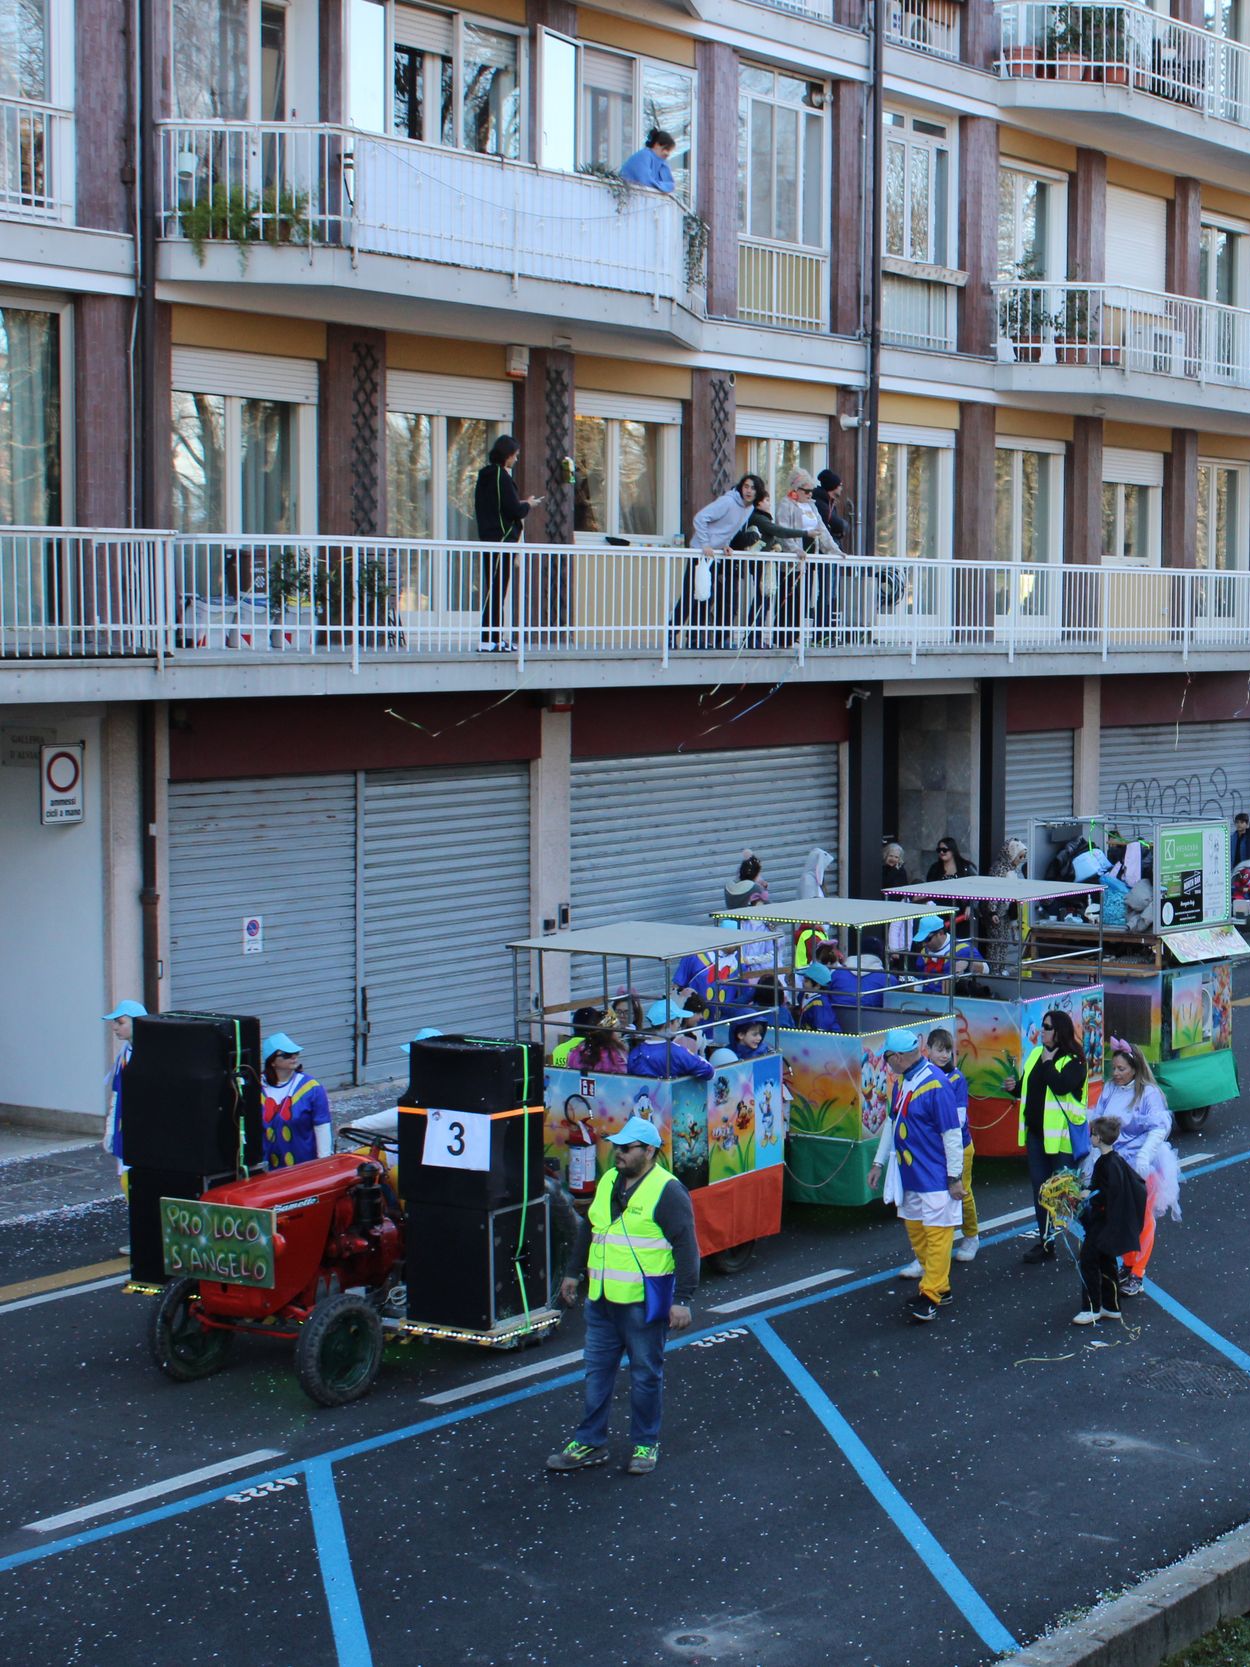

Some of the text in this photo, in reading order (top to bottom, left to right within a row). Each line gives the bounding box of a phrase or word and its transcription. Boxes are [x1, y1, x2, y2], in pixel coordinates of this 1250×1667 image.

[46, 808, 58, 818] cicli
[64, 809, 81, 817] mano
[50, 797, 76, 807] ammessi
[447, 1121, 465, 1156] 3
[167, 1205, 260, 1242] PRO LOCO
[190, 1247, 266, 1280] ANGELO
[689, 1328, 749, 1348] 4222
[224, 1477, 299, 1503] 4223
